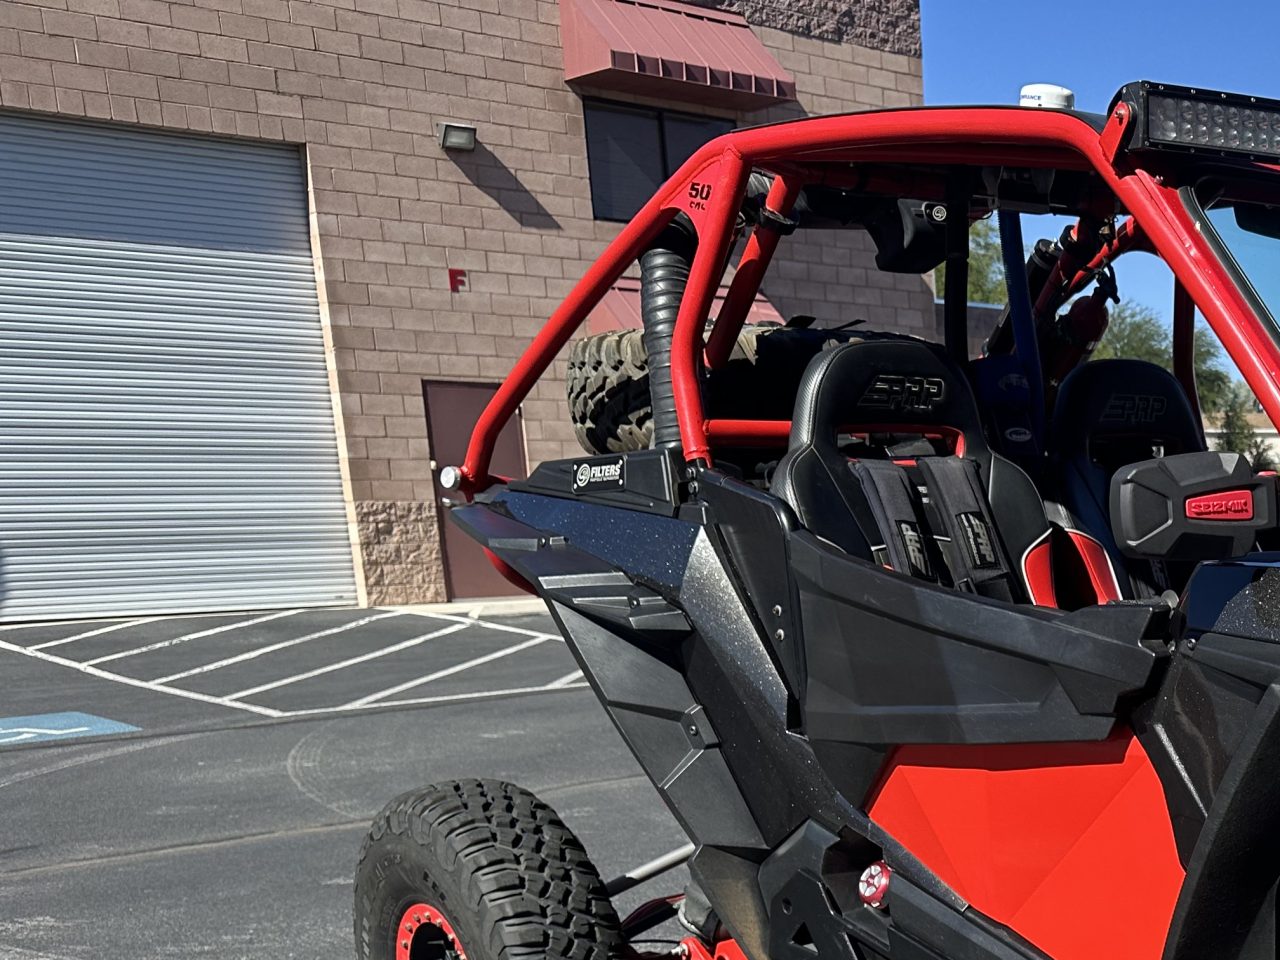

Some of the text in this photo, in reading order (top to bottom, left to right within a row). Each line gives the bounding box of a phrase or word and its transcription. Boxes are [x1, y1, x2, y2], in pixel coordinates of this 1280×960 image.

[688, 182, 712, 200] 50
[448, 268, 467, 293] F
[590, 464, 621, 478] FILTERS
[1190, 499, 1250, 516] SEIZMIK
